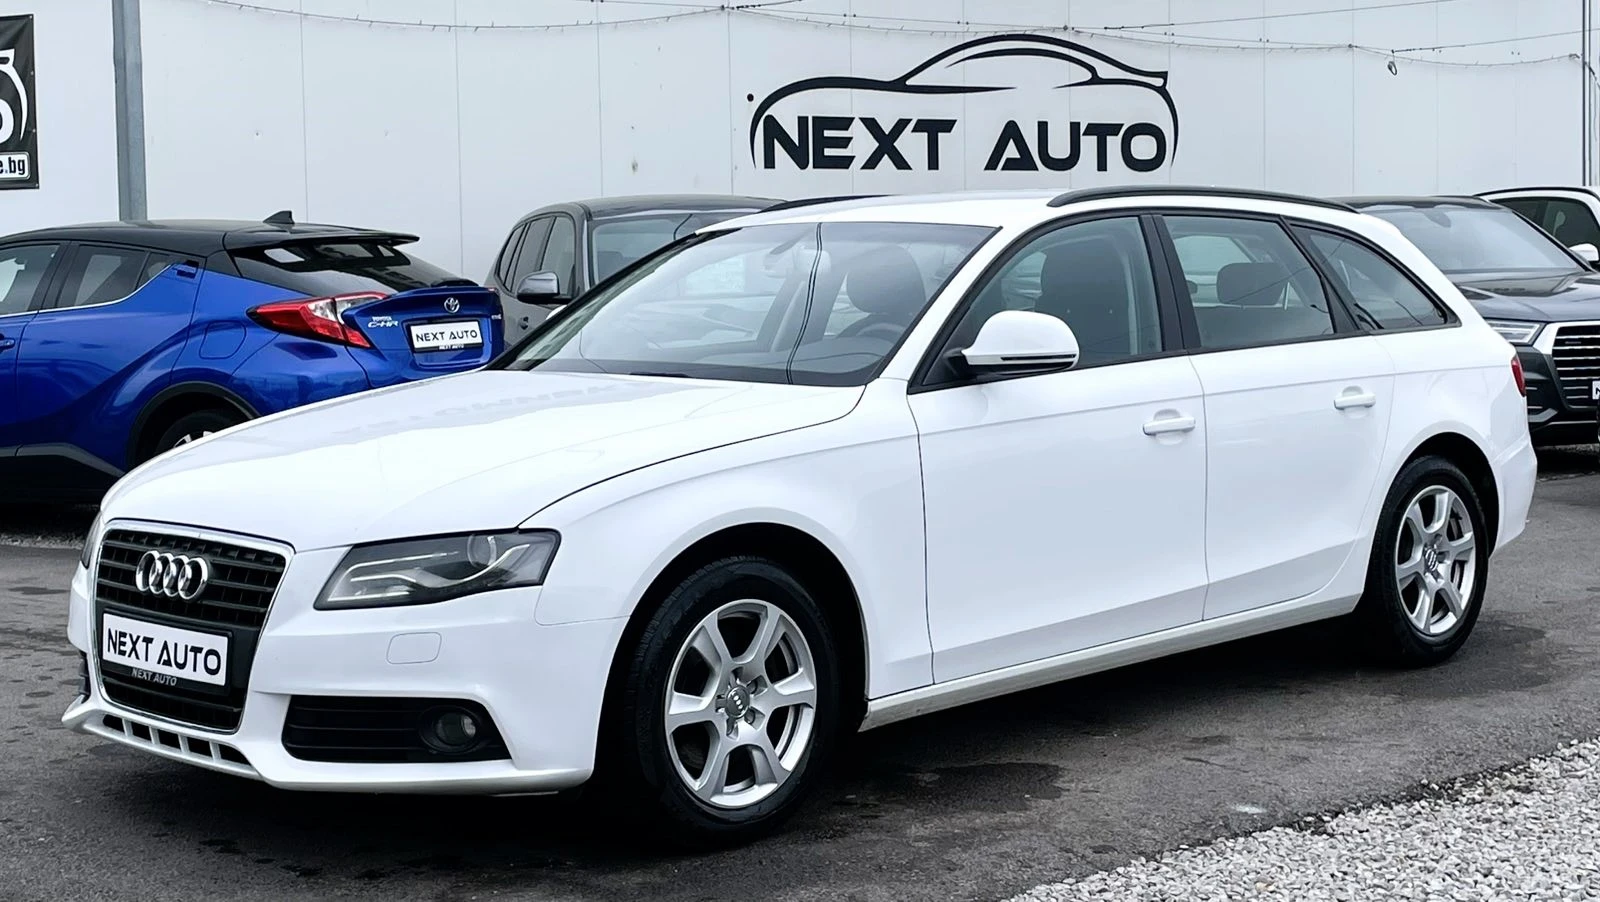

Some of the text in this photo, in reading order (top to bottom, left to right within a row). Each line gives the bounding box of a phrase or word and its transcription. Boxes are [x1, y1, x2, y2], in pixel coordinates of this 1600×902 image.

[763, 114, 1167, 172] NEXT AUTO
[416, 329, 478, 343] NEXT AUTO
[107, 627, 221, 675] NEXT AUTO
[131, 667, 178, 686] NEXT AUTO
